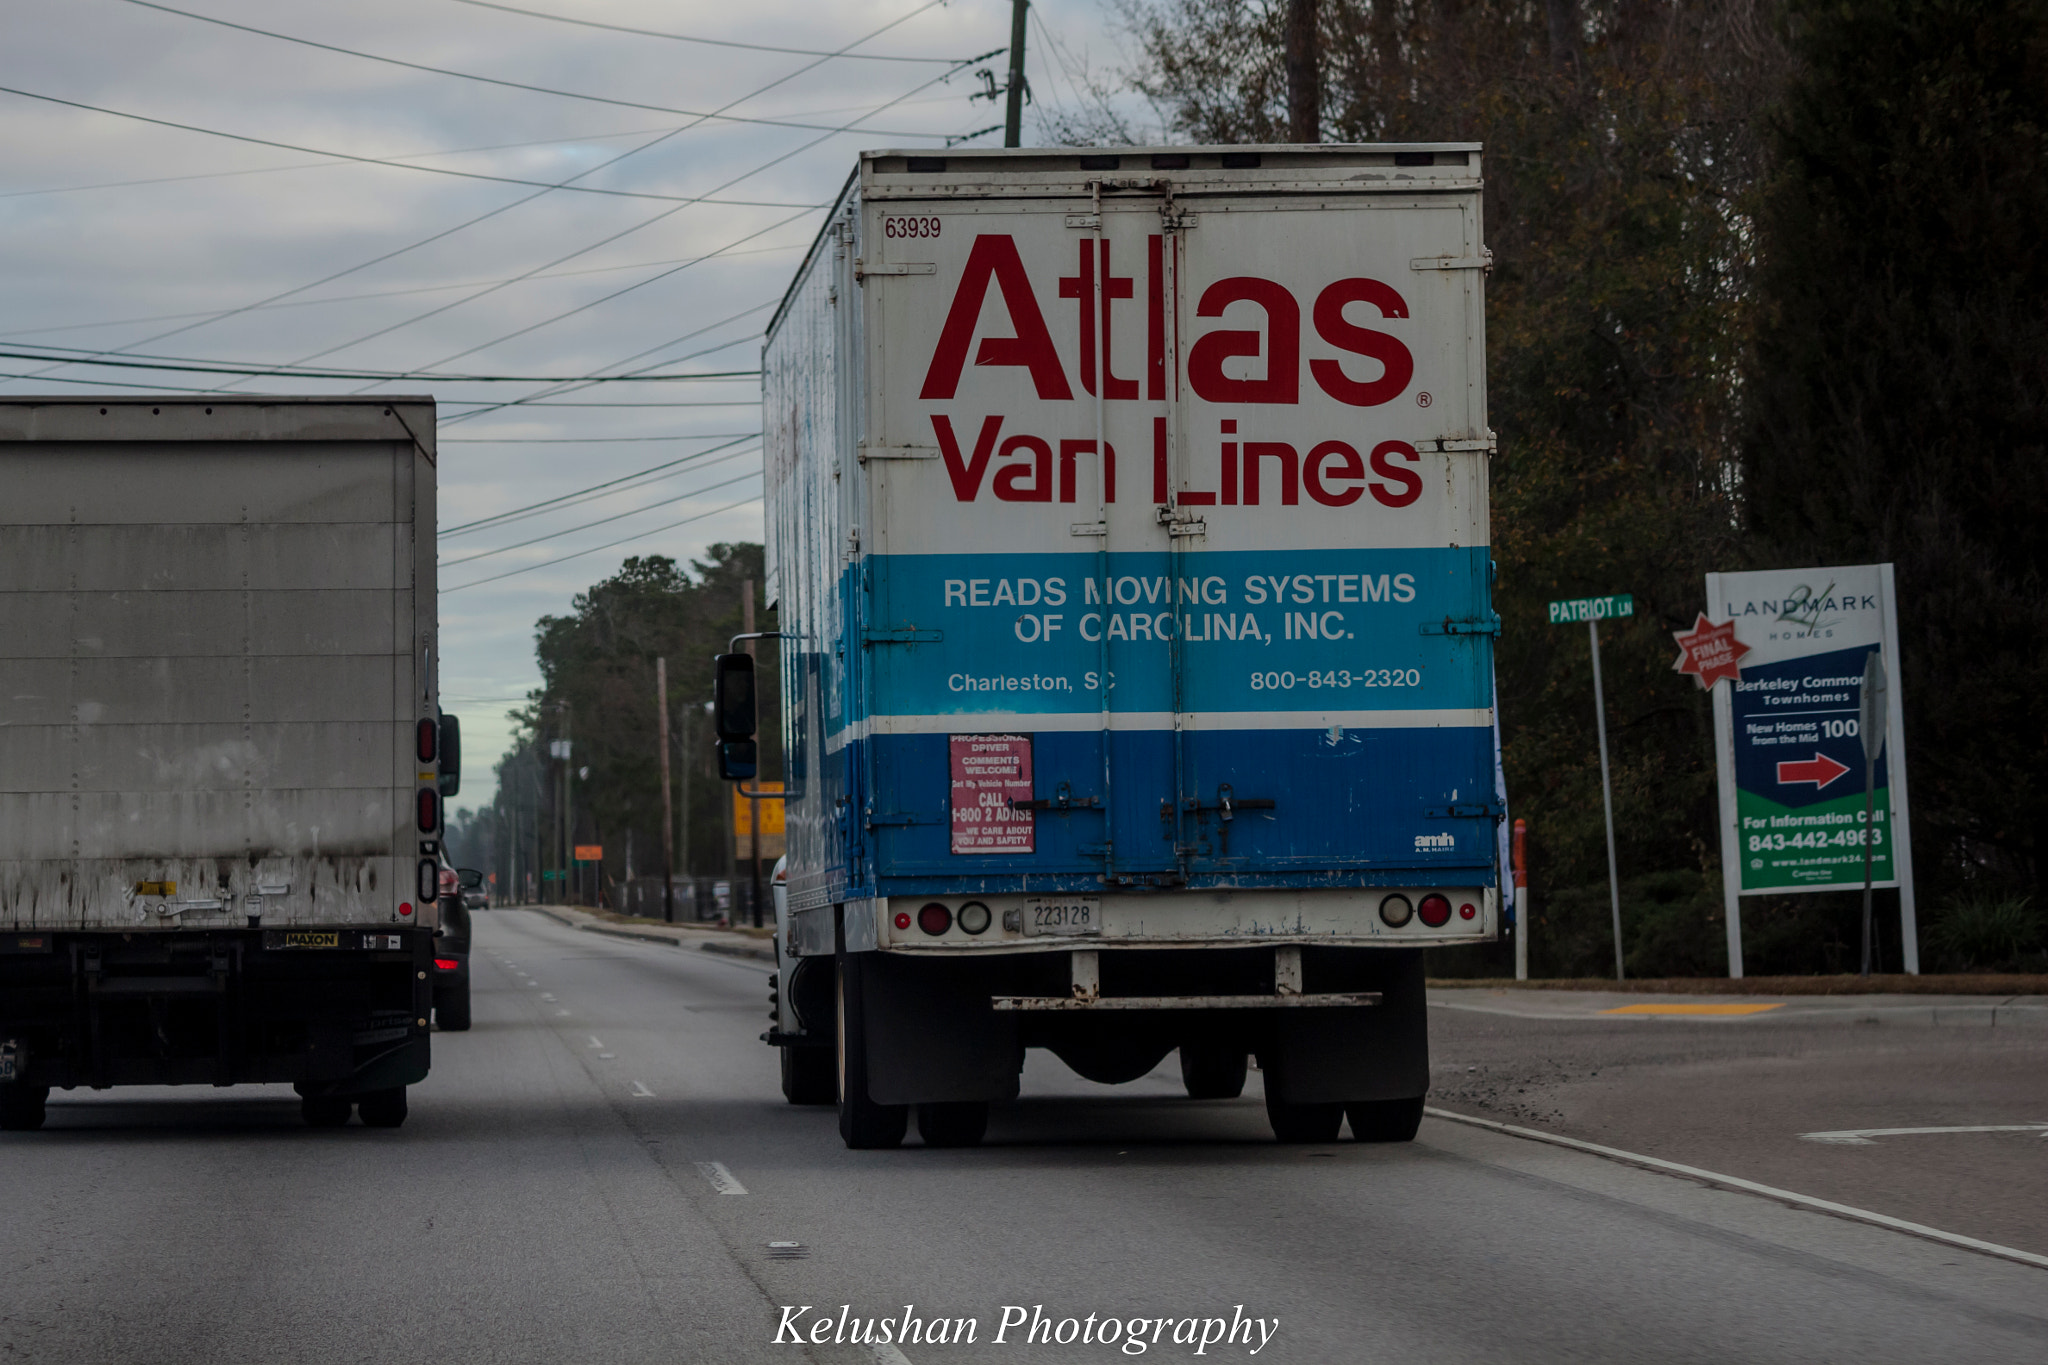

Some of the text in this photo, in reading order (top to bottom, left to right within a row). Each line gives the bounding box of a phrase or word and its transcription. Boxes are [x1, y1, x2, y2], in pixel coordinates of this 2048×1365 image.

[886, 217, 941, 238] 63939
[919, 234, 1414, 408] Atlas
[930, 414, 1423, 508] Van Lines
[945, 573, 1416, 607] READS MOVING SYSTEMS
[1549, 597, 1633, 623] PATRIOT LN
[1728, 595, 1875, 617] LANDMARK
[1014, 611, 1355, 646] OF CAROLINA, INC.
[1769, 629, 1834, 641] HOMES
[1692, 637, 1734, 661] FINAL
[1698, 651, 1735, 672] PHASE
[948, 669, 1421, 694] Charleston, SC 800-843-2320
[1735, 678, 1799, 692] Berkeley
[1763, 692, 1850, 705] Townhomes
[1746, 723, 1773, 735] New
[1775, 722, 1817, 733] Homes
[1751, 732, 1819, 745] from the Mid
[971, 743, 1009, 752] DRIVER
[962, 756, 1020, 765] COMMENTS
[965, 766, 1017, 775] WELCOME
[1005, 778, 1031, 787] Number
[979, 792, 1005, 807] CALL
[952, 807, 1033, 822] 1-800 2 ADVISE
[1743, 809, 1885, 829] For Information Cll
[982, 827, 1003, 835] CARE
[1006, 826, 1033, 834] ABOUT
[977, 836, 995, 844] AND
[997, 836, 1027, 844] SAFETY
[1748, 828, 1884, 852] 843-442-4963
[1771, 854, 1887, 867] www.landmark24.om
[1034, 906, 1090, 926] 223128
[287, 934, 335, 946] MAXON
